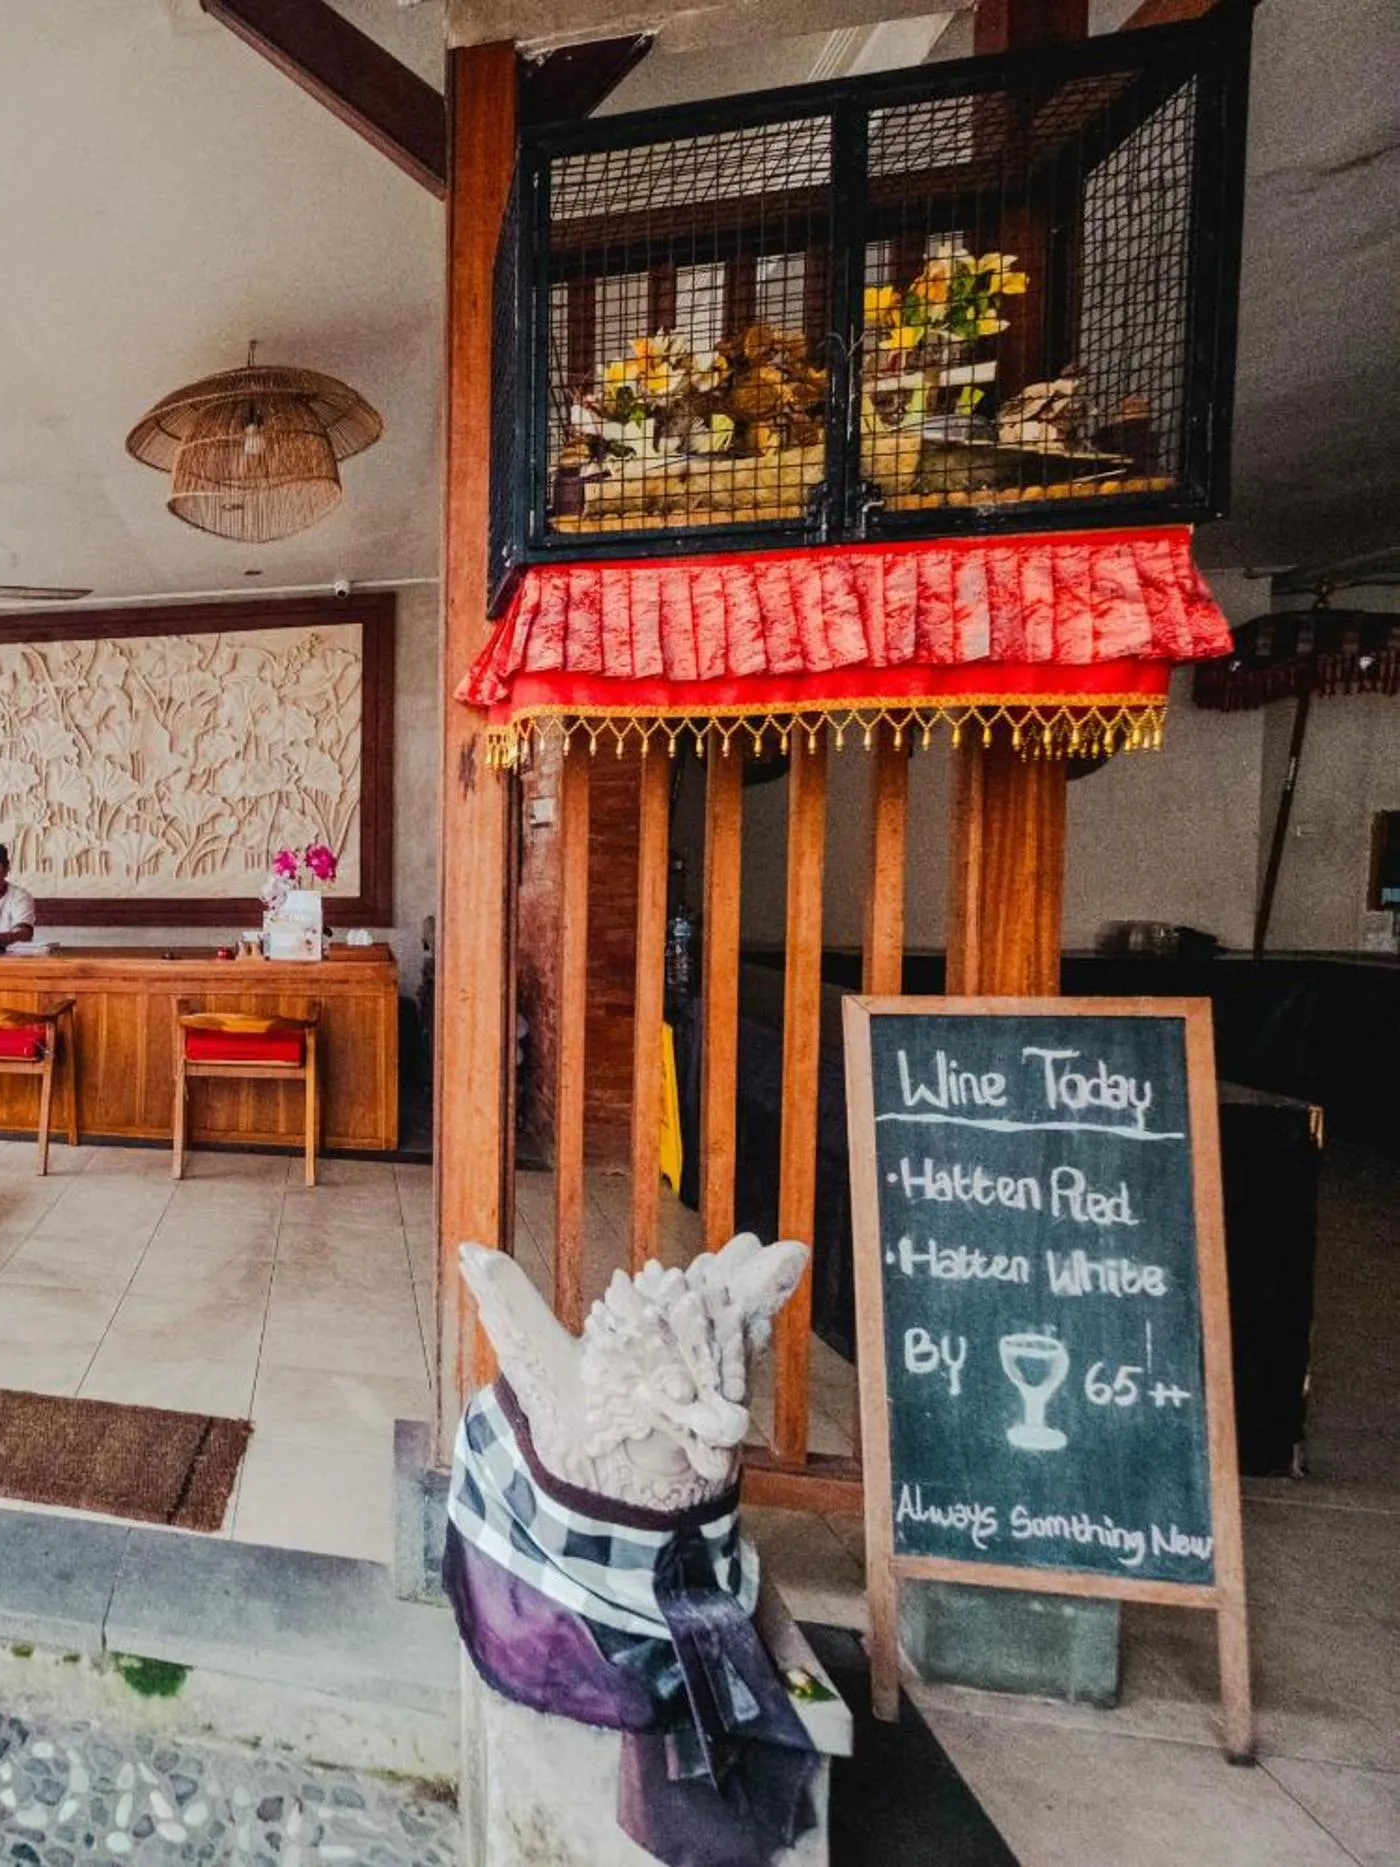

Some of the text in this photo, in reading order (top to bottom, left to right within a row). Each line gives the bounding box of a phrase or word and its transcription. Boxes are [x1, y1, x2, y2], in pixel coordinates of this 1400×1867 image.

[897, 1046, 1152, 1131] Wine Today
[900, 1157, 1139, 1225] Hatten Red
[898, 1235, 1168, 1298] Hatten White
[903, 1327, 967, 1396] By
[896, 1484, 998, 1550] Always
[1010, 1504, 1146, 1567] Somthing
